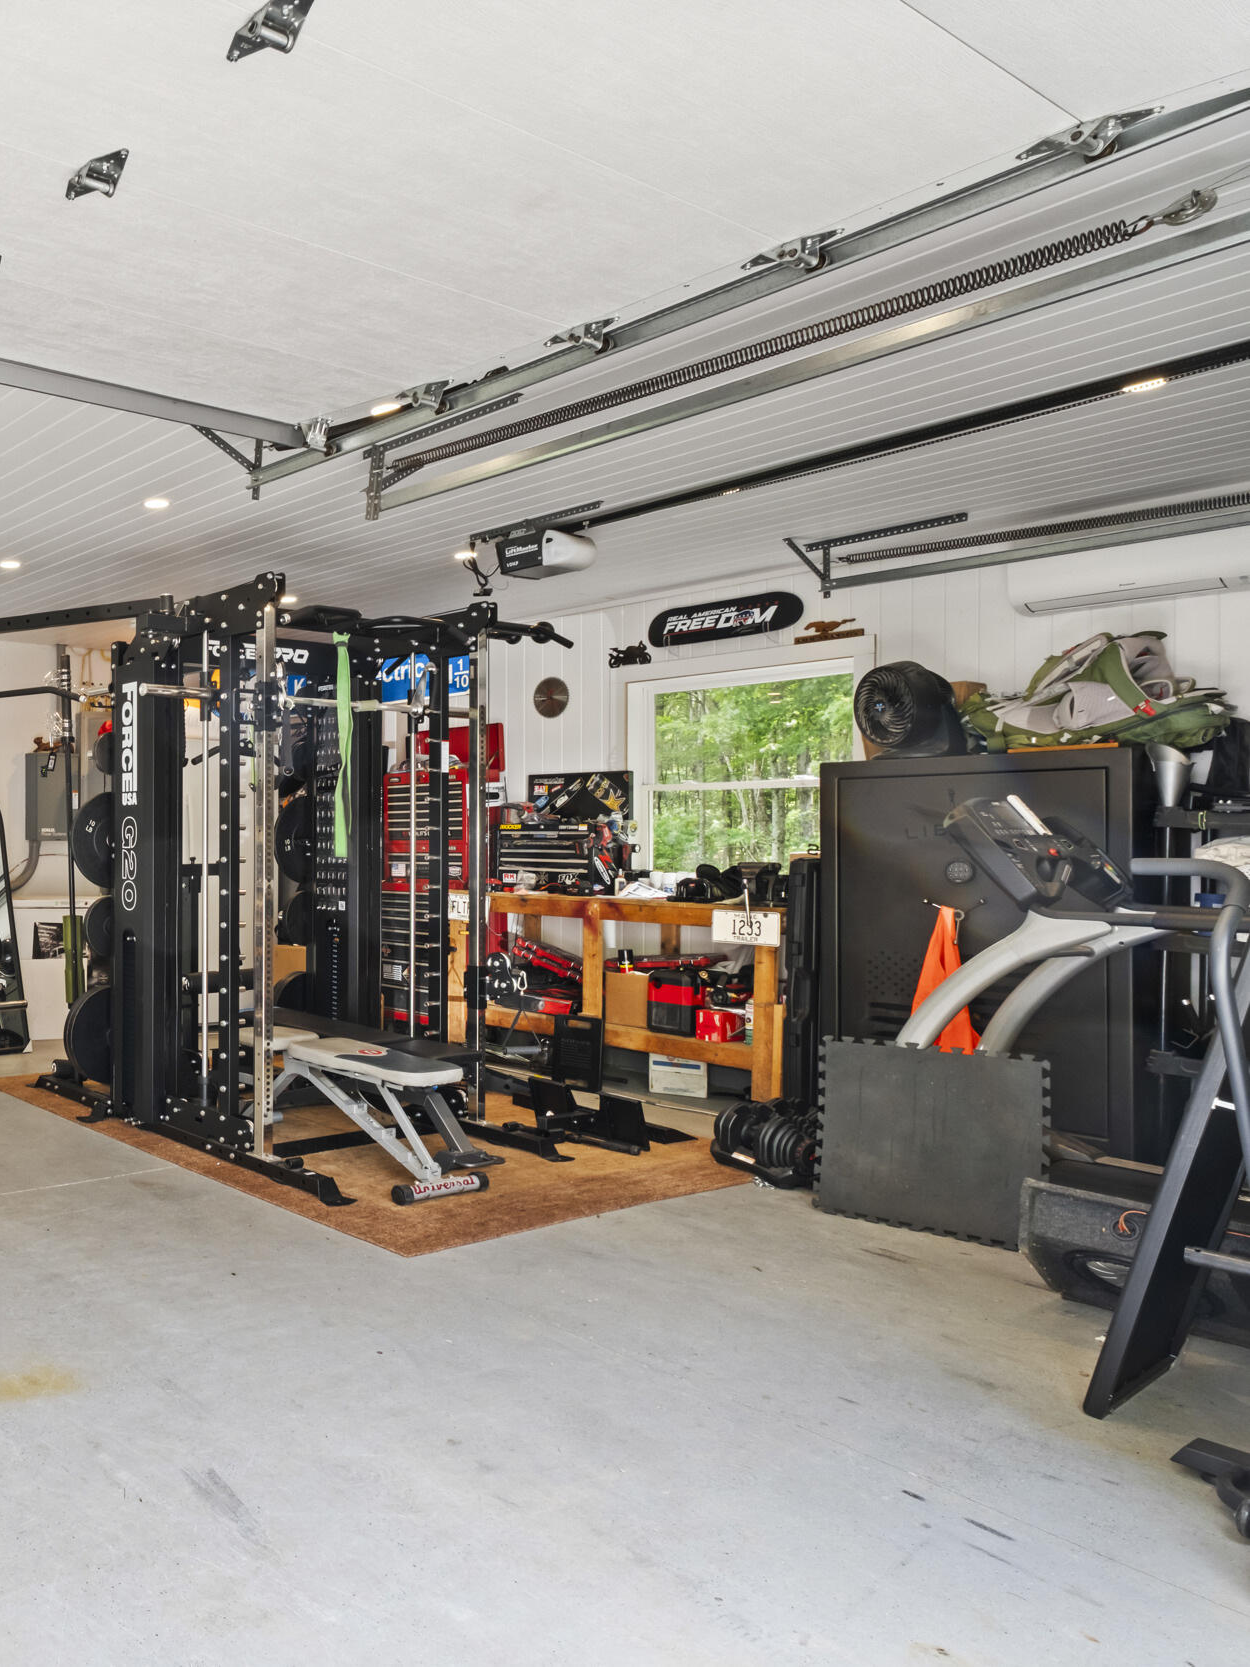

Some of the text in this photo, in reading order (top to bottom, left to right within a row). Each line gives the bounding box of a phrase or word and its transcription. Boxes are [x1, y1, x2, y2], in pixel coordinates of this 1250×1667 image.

[667, 606, 737, 622] REAL AMERICAN
[121, 681, 138, 806] FORCE USA
[121, 816, 138, 911] G20
[412, 1175, 476, 1194] Universal
